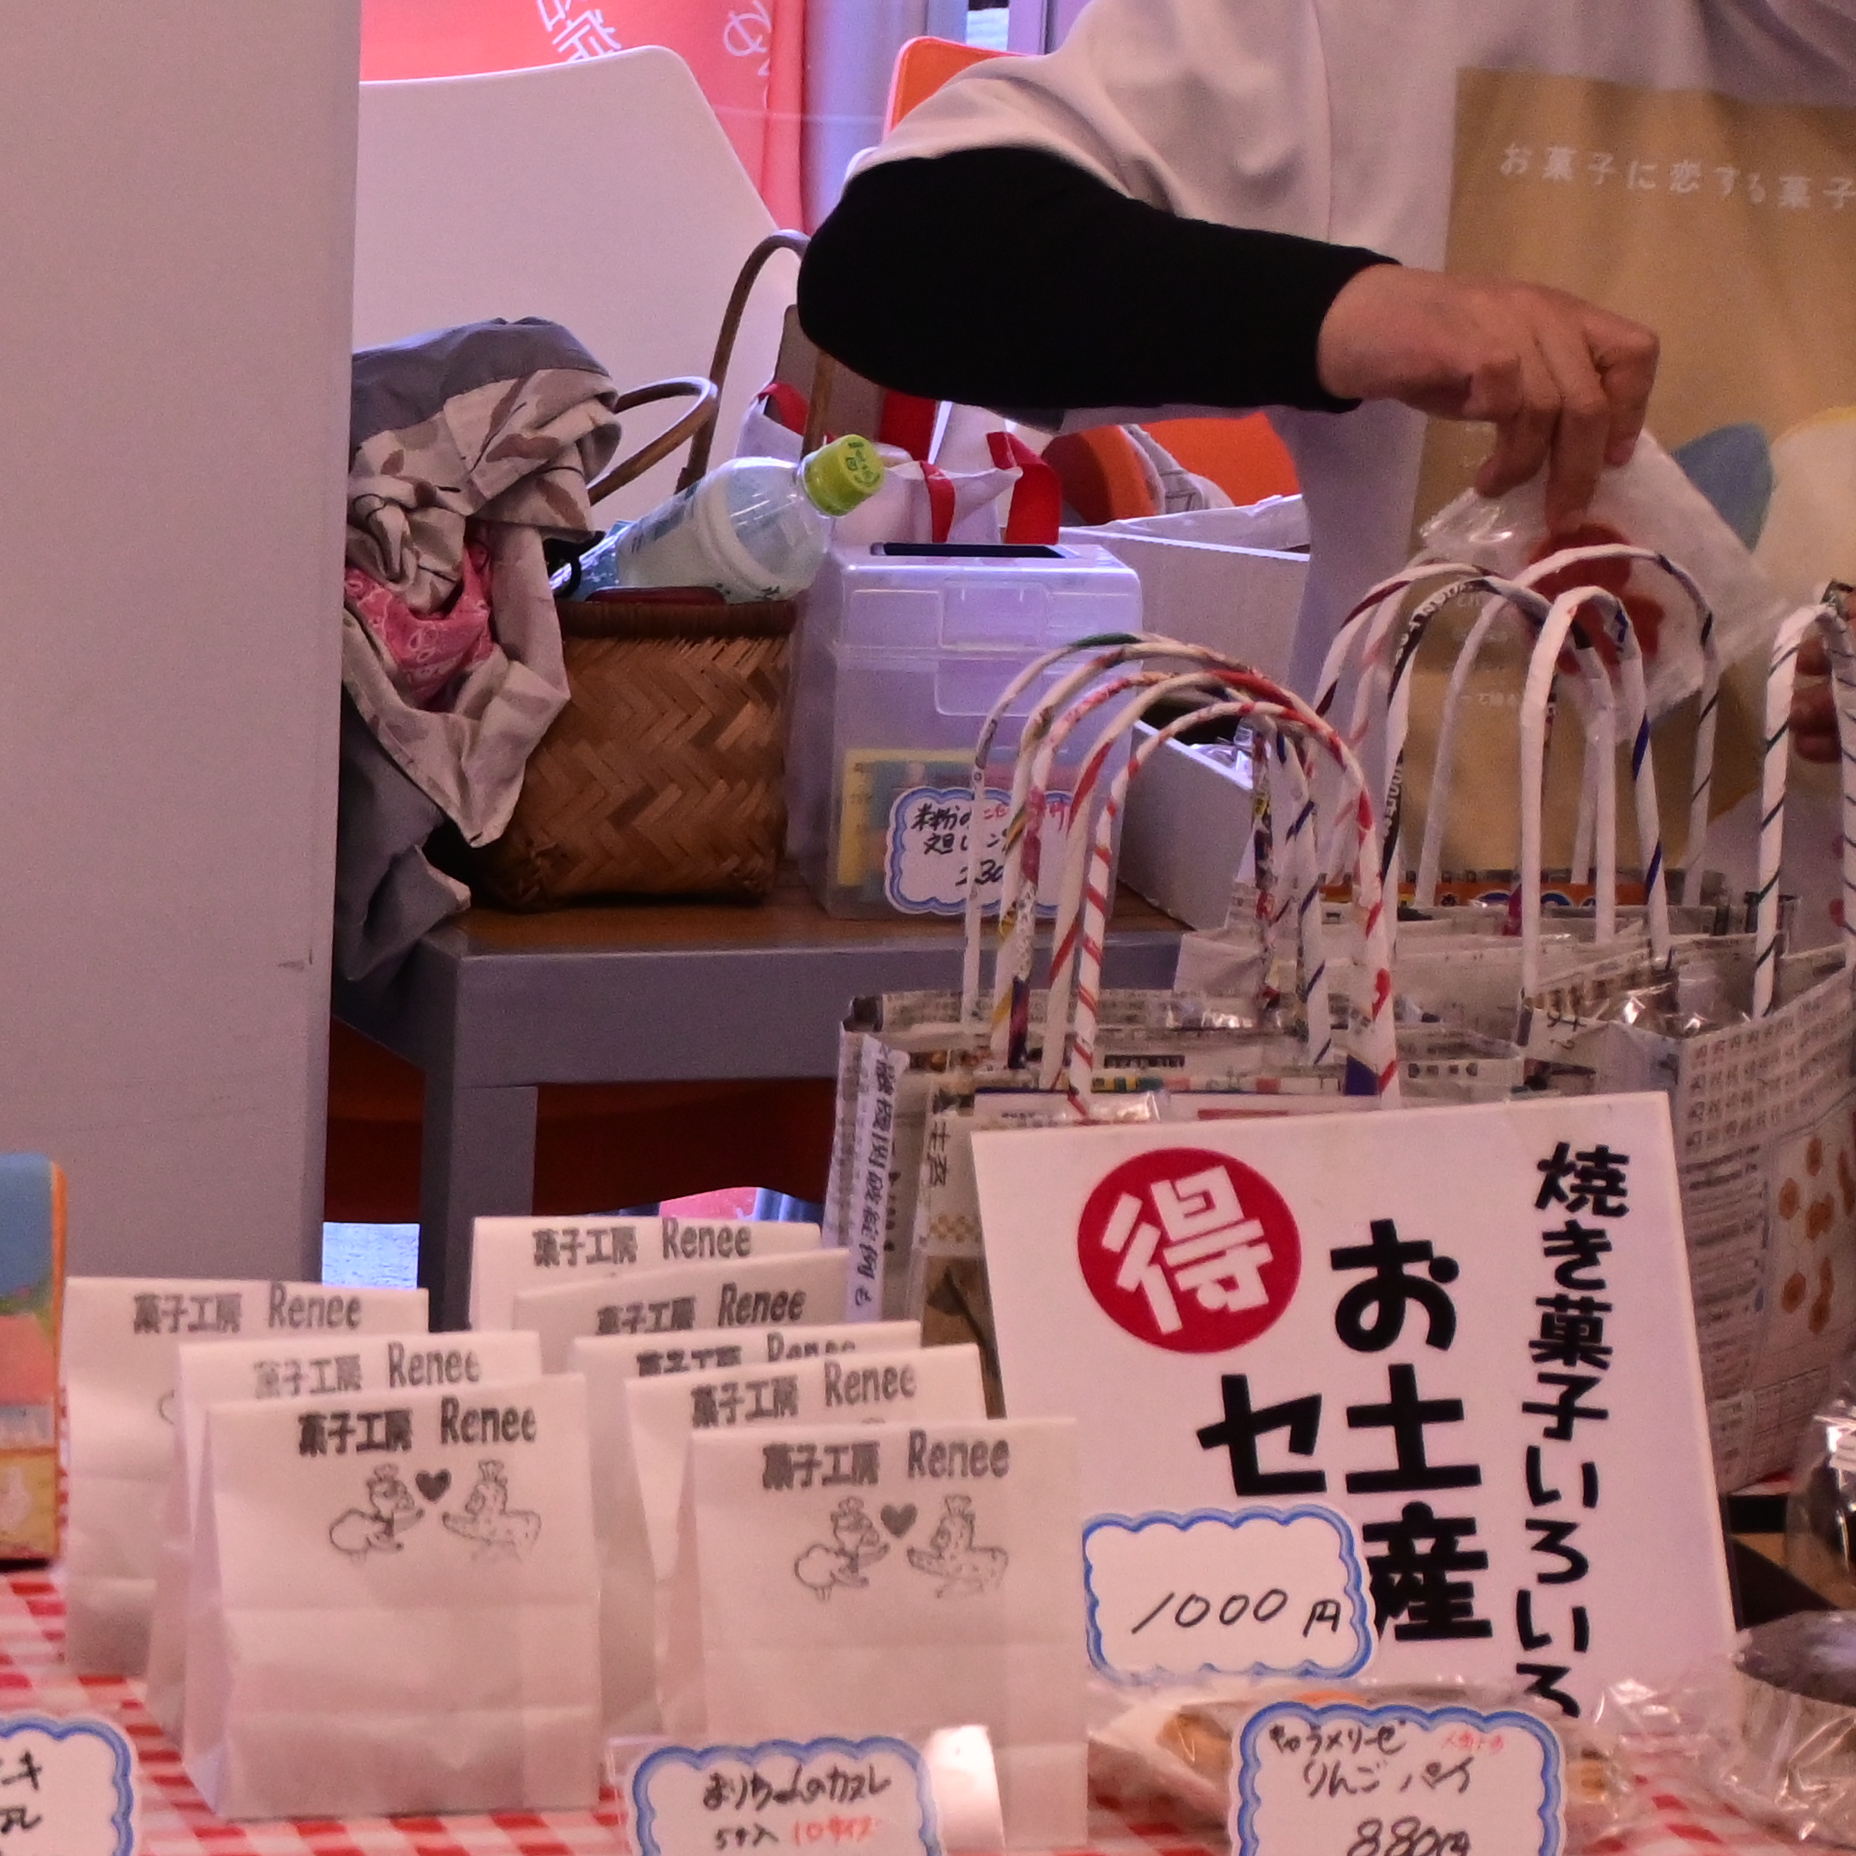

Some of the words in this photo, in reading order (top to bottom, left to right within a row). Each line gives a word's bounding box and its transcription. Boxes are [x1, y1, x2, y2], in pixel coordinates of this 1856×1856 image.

[532, 1225, 637, 1268] 菓子工房
[661, 1217, 752, 1260] Renee
[1099, 1164, 1275, 1338] 得
[132, 1292, 243, 1335] 菓子工房
[268, 1280, 363, 1330] Renee
[597, 1295, 697, 1336] 菓子工房
[717, 1282, 807, 1327] Renee
[253, 1353, 363, 1400] 菓子工房
[387, 1341, 480, 1389] Renee
[691, 1374, 799, 1429] 菓子工房
[824, 1361, 917, 1408] Renee
[297, 1408, 413, 1458] 菓子工房
[439, 1395, 537, 1446] Renee
[1328, 1217, 1494, 1645] お土産
[1514, 1140, 1631, 1720] 焼き菓子いろいろ
[761, 1440, 881, 1492] 菓子工房
[906, 1428, 1011, 1480] Renee
